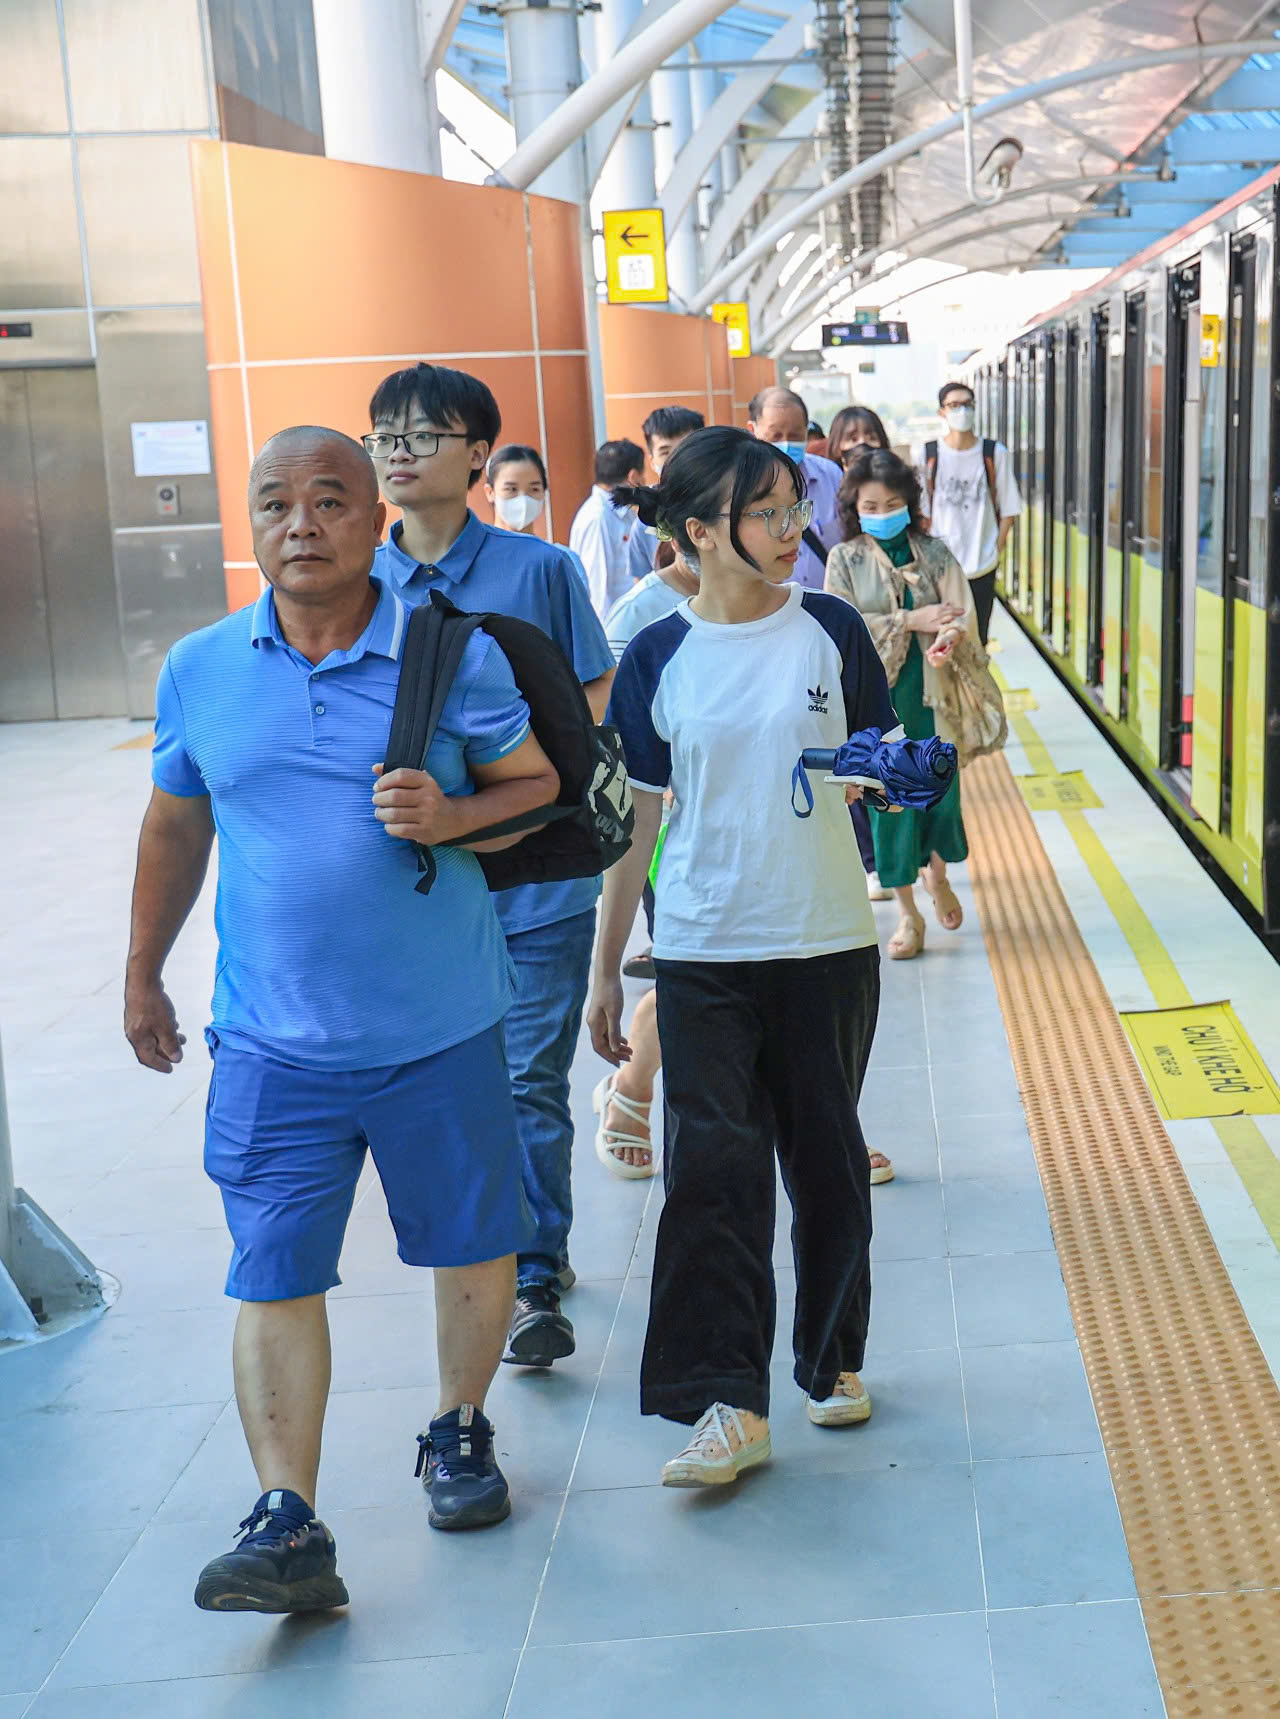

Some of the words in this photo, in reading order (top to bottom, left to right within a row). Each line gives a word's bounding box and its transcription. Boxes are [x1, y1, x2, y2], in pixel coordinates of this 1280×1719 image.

[808, 704, 828, 714] adidas
[1181, 1024, 1233, 1045] CHÚ
[1196, 1055, 1242, 1076] KHE
